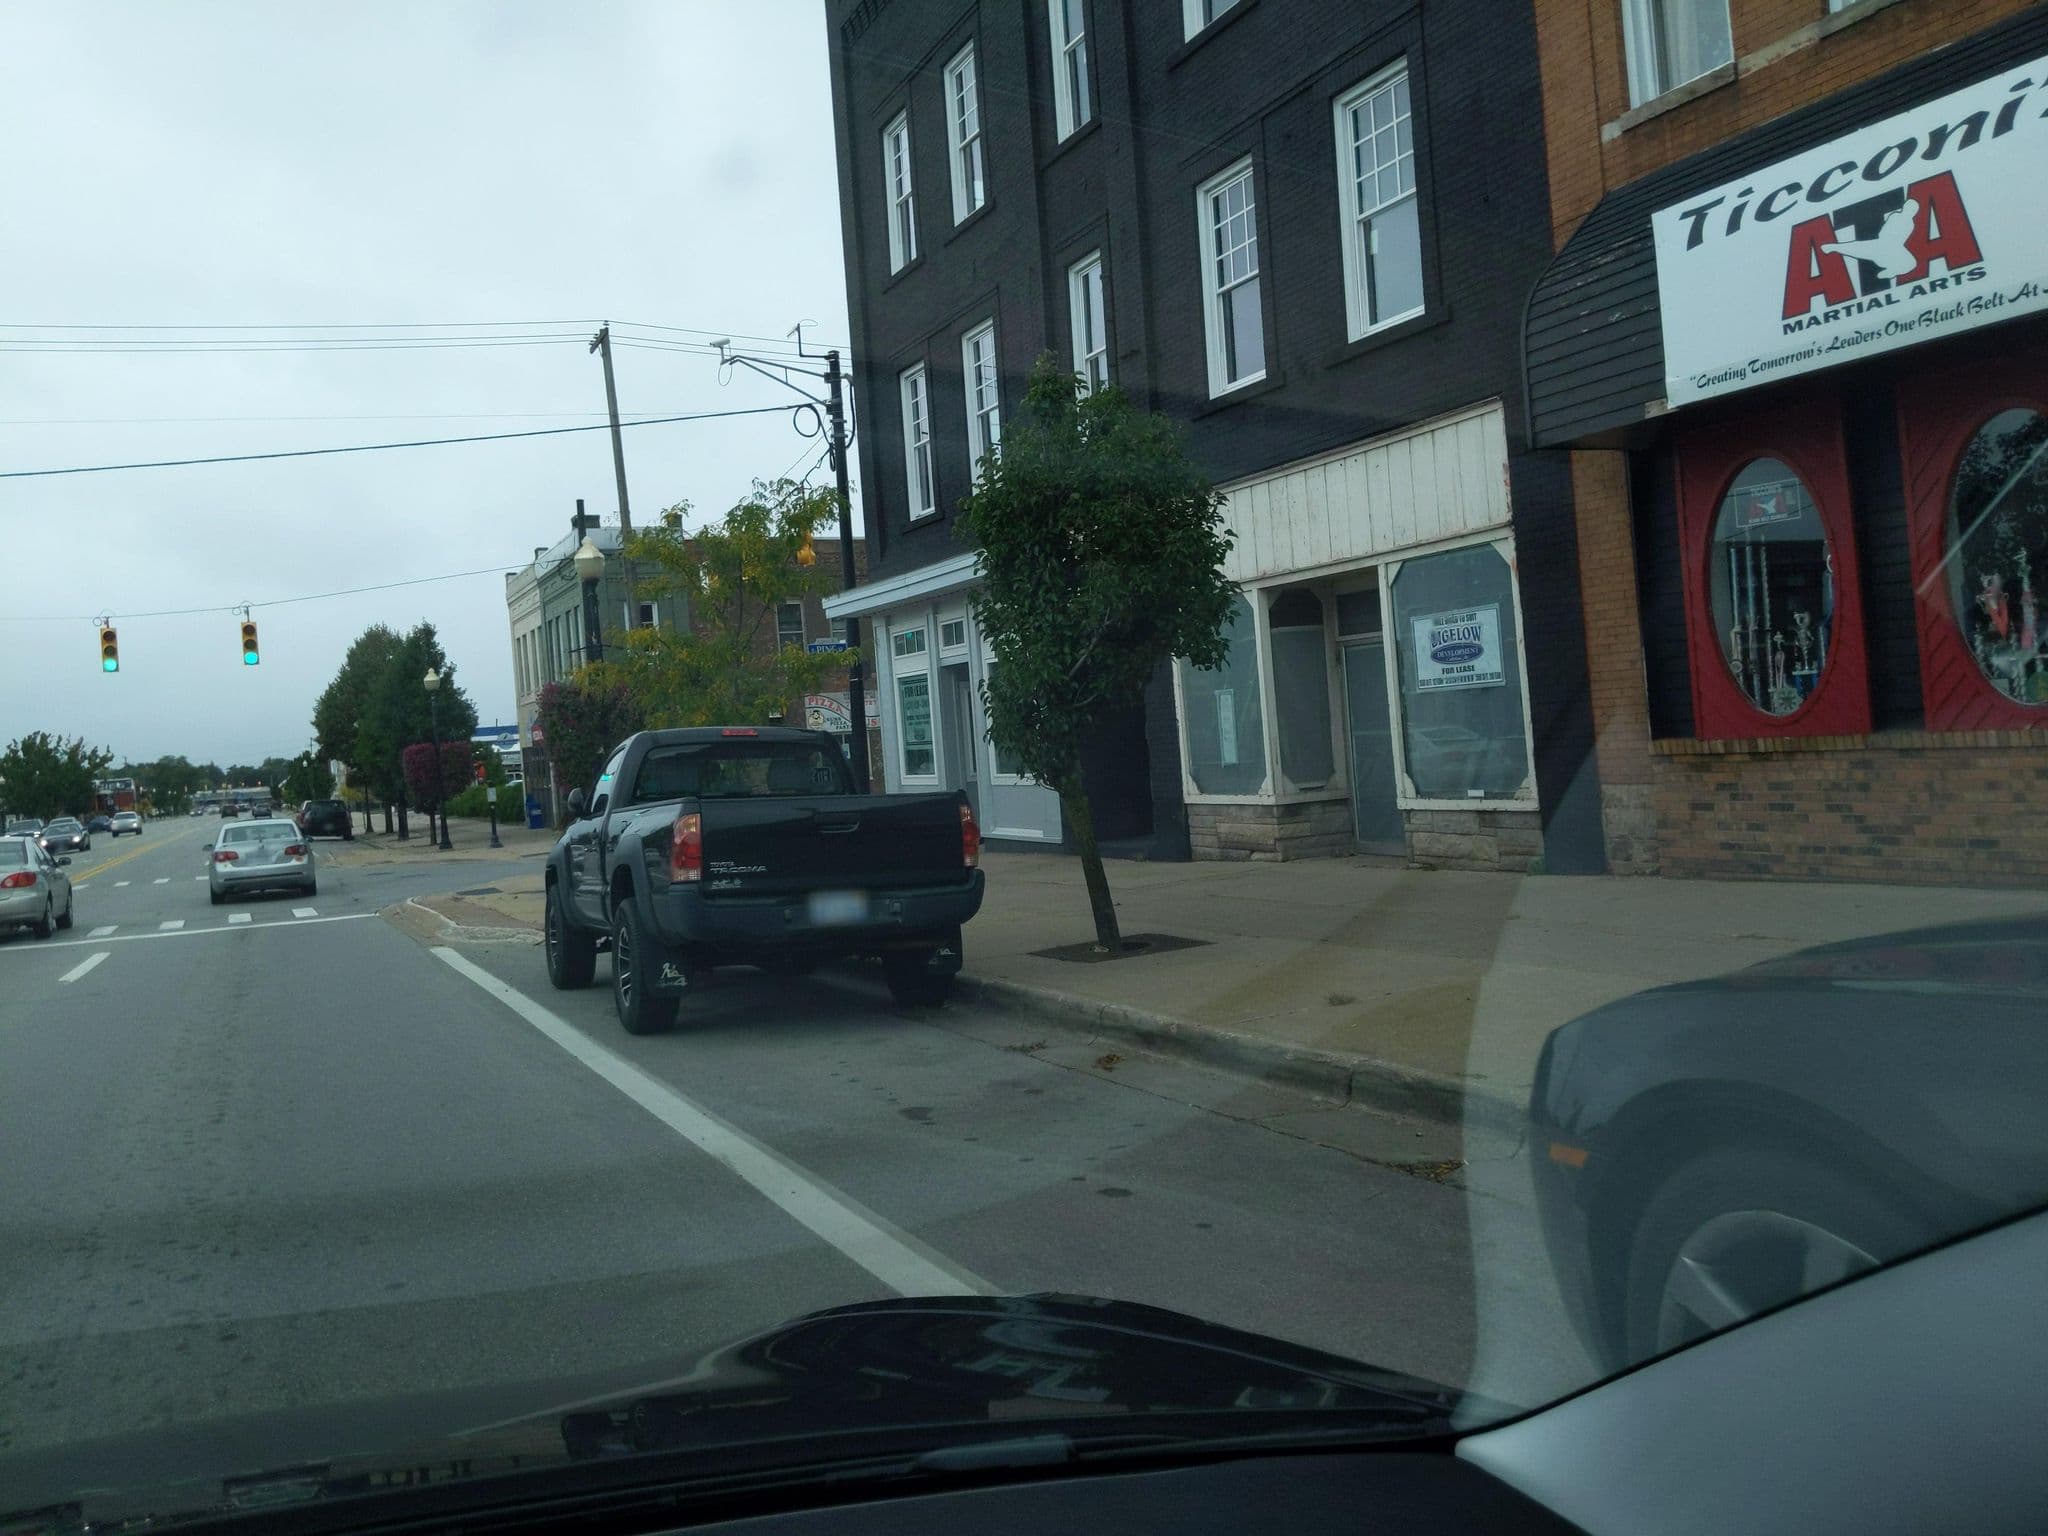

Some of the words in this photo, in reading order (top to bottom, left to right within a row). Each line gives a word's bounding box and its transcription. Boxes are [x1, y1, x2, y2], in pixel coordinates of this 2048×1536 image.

[1782, 169, 1984, 320] ATA
[1782, 293, 1900, 336] MARTIAL
[1909, 266, 1987, 299] ARTS
[1748, 341, 1823, 374] Tomorrow's
[1825, 329, 1882, 353] Leaders
[1884, 319, 1916, 336] One
[1918, 302, 1965, 328] Black
[1967, 291, 2004, 315] Belt
[2007, 282, 2039, 303] At
[1437, 647, 1480, 658] DEVELOPMENT
[1442, 667, 1455, 675] FOR
[1456, 665, 1475, 673] LEASE
[807, 695, 843, 715] PIZZA
